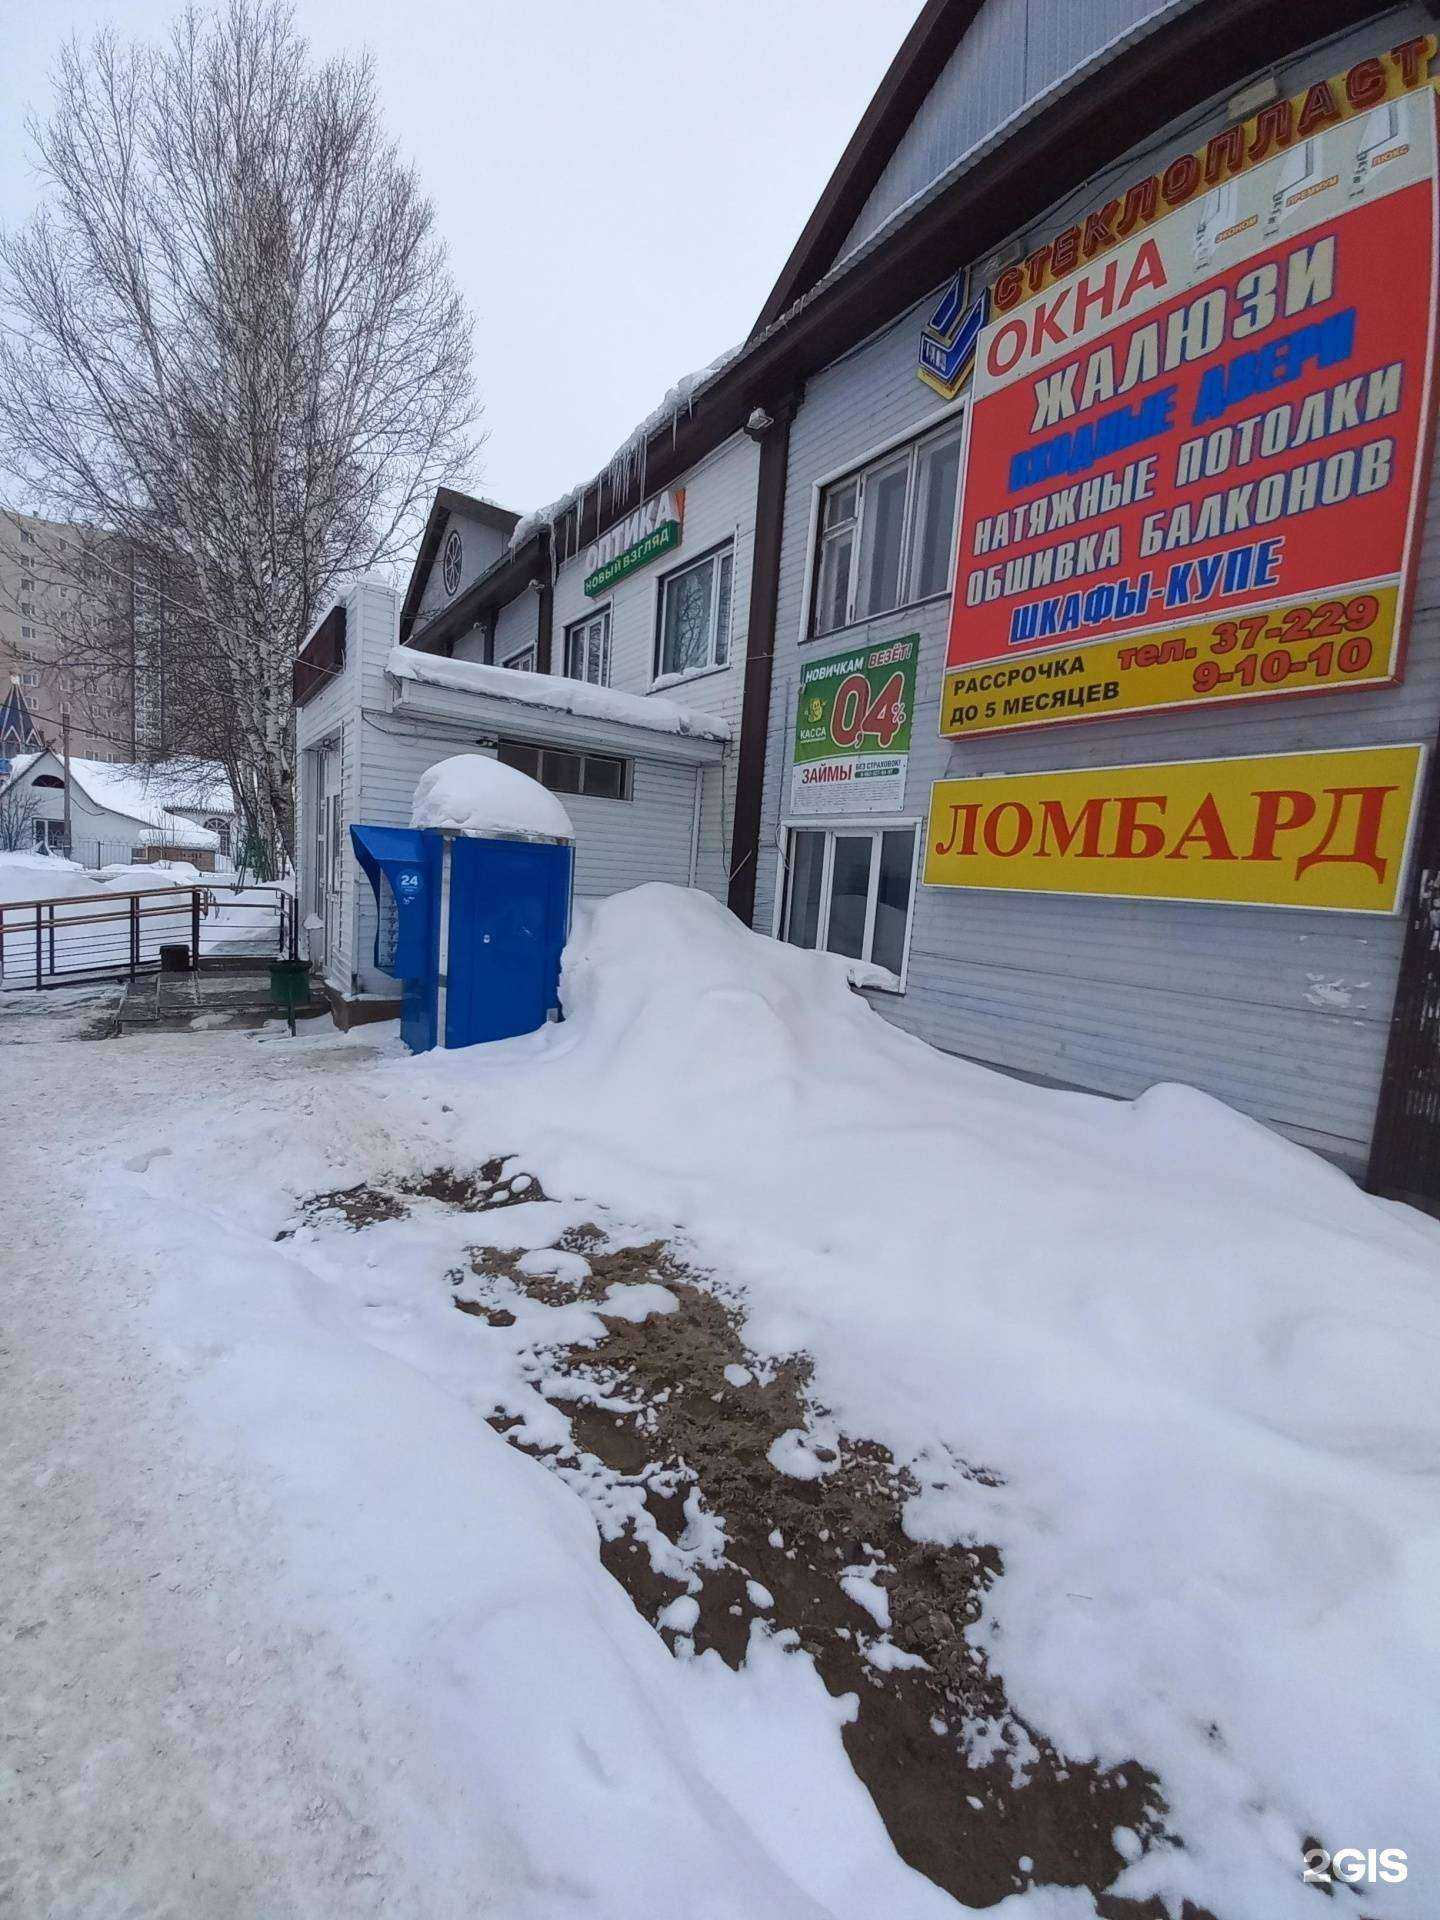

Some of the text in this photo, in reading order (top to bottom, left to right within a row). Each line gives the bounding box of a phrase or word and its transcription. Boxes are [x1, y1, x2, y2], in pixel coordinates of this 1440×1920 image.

[993, 35, 1430, 310] СТЕКЛОПЛАСТ
[986, 238, 1168, 378] ОКНА
[1030, 235, 1336, 434] ЖАЛЮЗИ
[1008, 306, 1357, 493] ВХОДНЫЕ ДВЕРИ
[973, 360, 1404, 556] НАТЯЖНЫЕ ПОТОЛКИ
[585, 490, 674, 573] ОПТИКА
[585, 527, 670, 592] НОВЫЙ ВЗГЛЯД
[966, 437, 1394, 608] ОБШИВКА БАЛКОНОВ
[1008, 535, 1285, 645] ШКАФЫ-КУПЕ
[805, 657, 864, 684] НОВИЧКАМ
[1117, 595, 1380, 671] тел. 37-229
[1192, 637, 1374, 693] 9-10-10
[950, 680, 1119, 726] ДО 5 МЕСЯЦЕВ
[953, 655, 1085, 696] РАССРОЧКА
[800, 727, 827, 740] КАССА
[801, 763, 852, 784] ЗАЙМЫ
[935, 785, 1400, 884] ЛОМБАРД
[401, 874, 418, 886] 24
